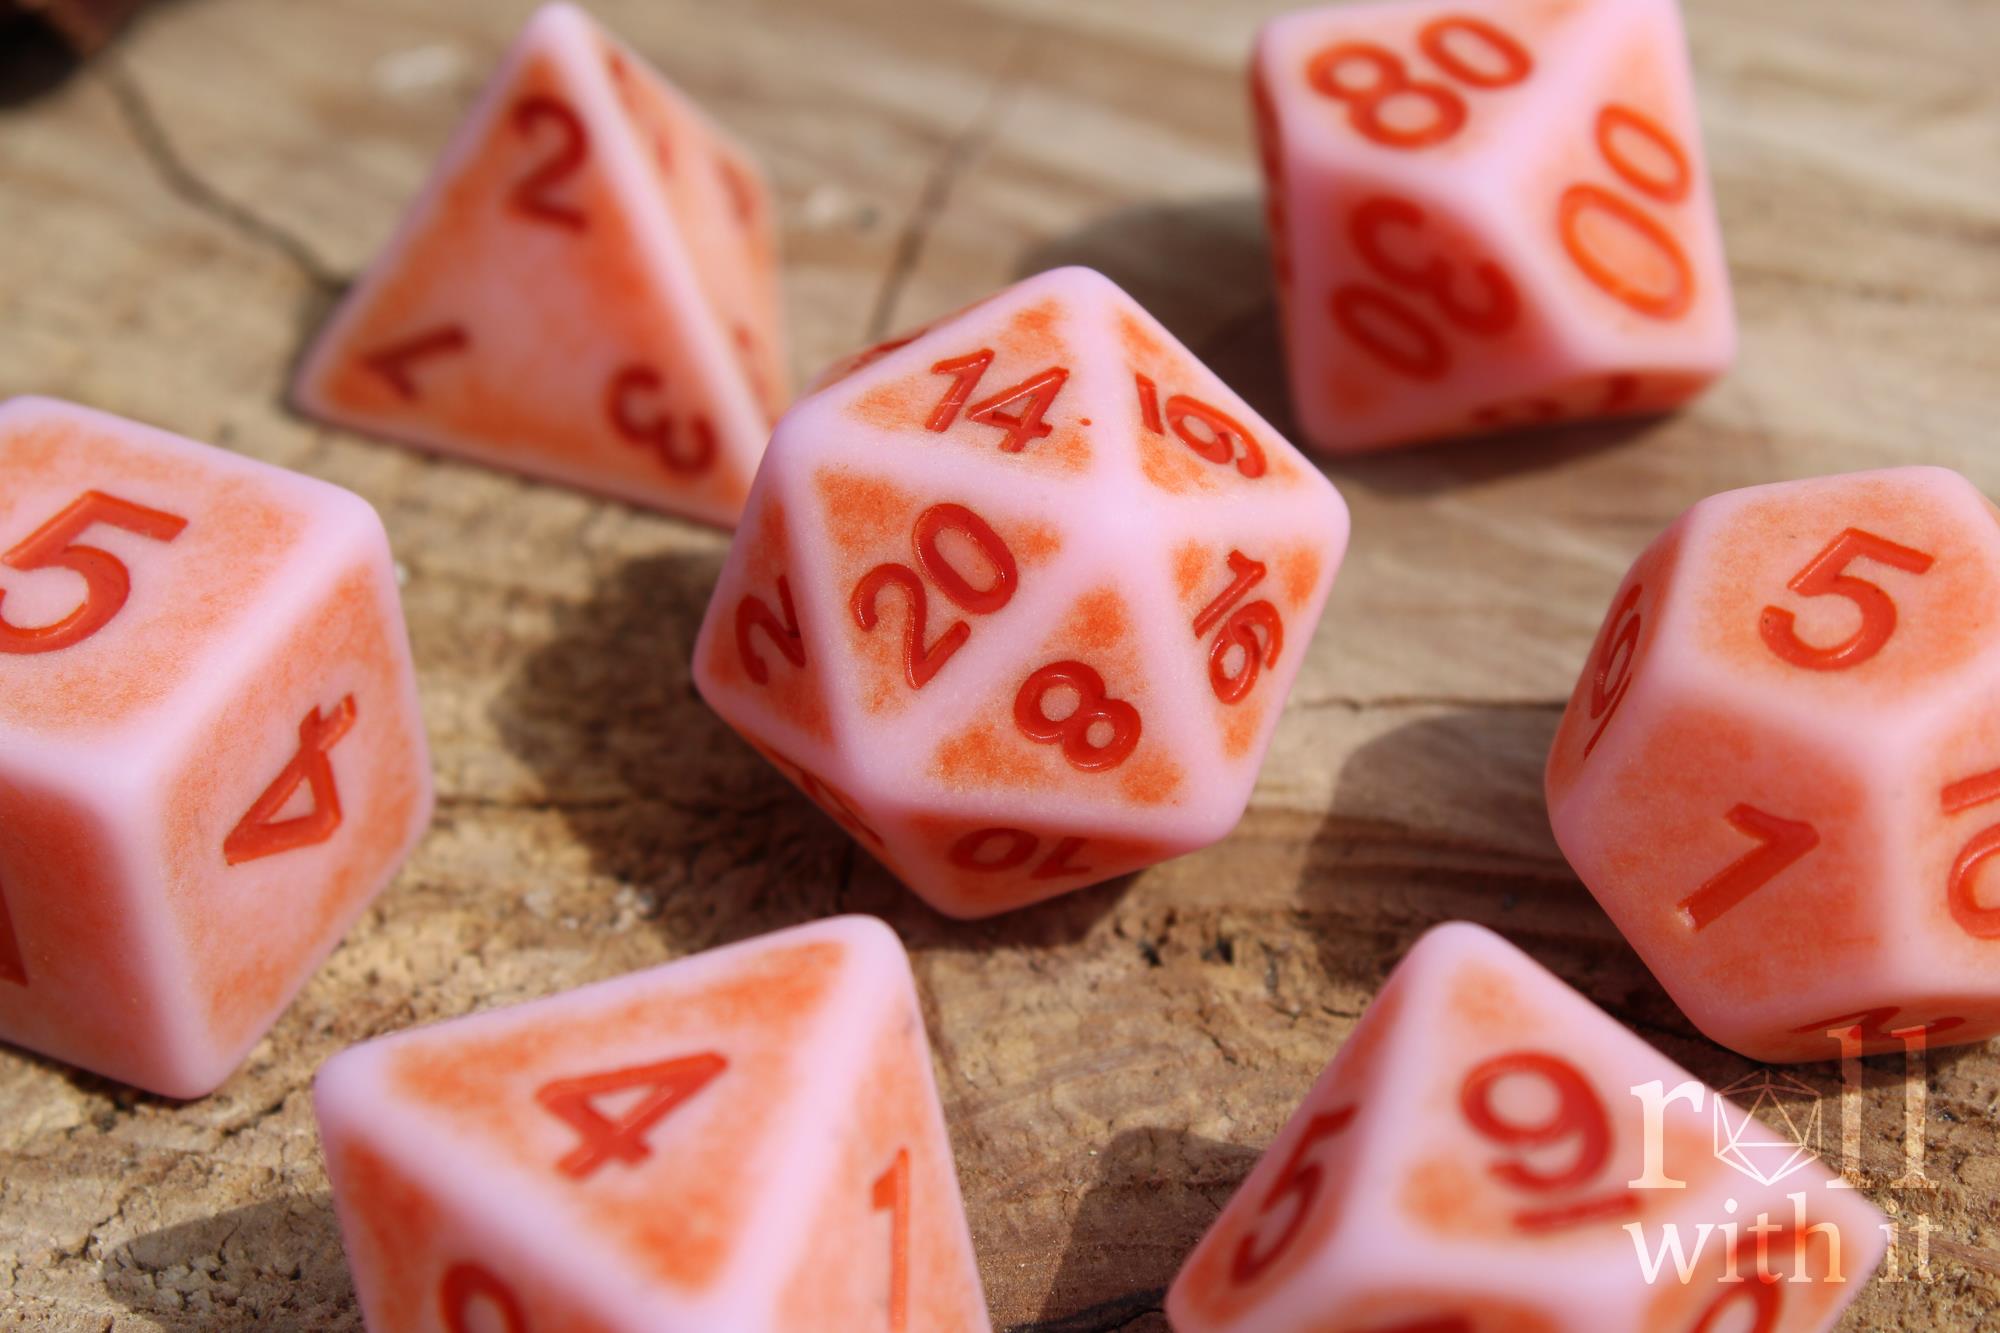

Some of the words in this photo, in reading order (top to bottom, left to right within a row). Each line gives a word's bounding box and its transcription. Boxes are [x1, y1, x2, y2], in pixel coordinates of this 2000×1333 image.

[1305, 16, 1532, 151] 80
[507, 92, 588, 233] 2
[1558, 105, 1695, 320] 00
[361, 321, 470, 402] 1
[1328, 196, 1521, 384] 30
[604, 363, 720, 483] 3
[926, 348, 1069, 453] 14
[0, 489, 189, 655] 5
[735, 575, 806, 685] 2
[849, 502, 1018, 690] 20
[1193, 549, 1285, 705] 16
[1759, 527, 1934, 672] 5
[223, 693, 357, 867] 4
[1013, 660, 1142, 773] 8
[947, 826, 1093, 881] 10
[1677, 803, 1821, 933] 1
[535, 1051, 729, 1182] 4
[1460, 1050, 1646, 1233] 9
[870, 1146, 911, 1333] 1
[1230, 1102, 1362, 1288] 5
